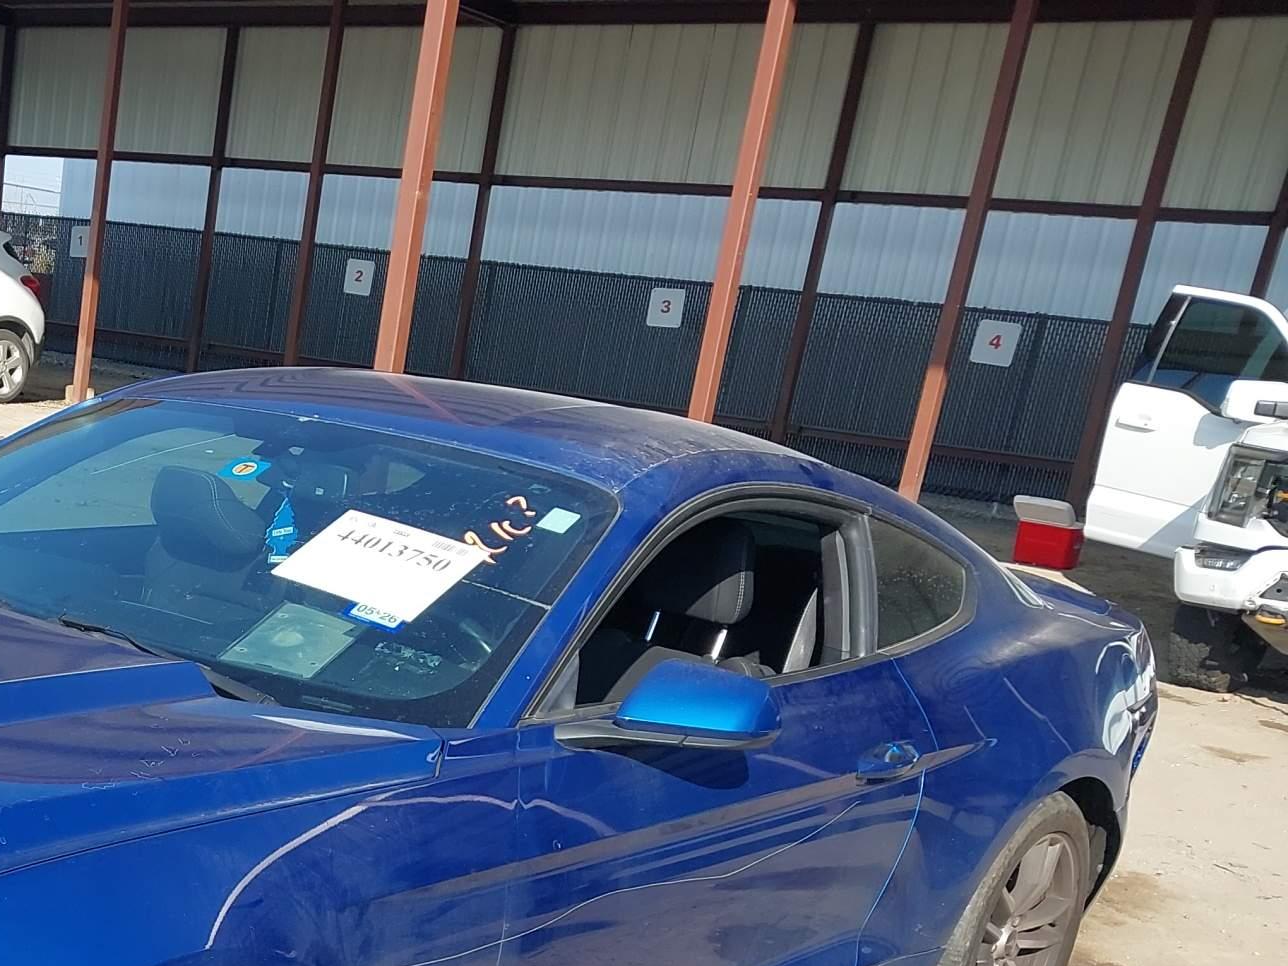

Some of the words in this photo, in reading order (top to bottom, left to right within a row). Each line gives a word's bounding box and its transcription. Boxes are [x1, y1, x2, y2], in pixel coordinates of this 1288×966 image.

[77, 235, 83, 246] 1
[354, 270, 364, 283] 2
[660, 299, 672, 314] 3
[988, 334, 1002, 350] 4
[336, 529, 452, 572] 44013750
